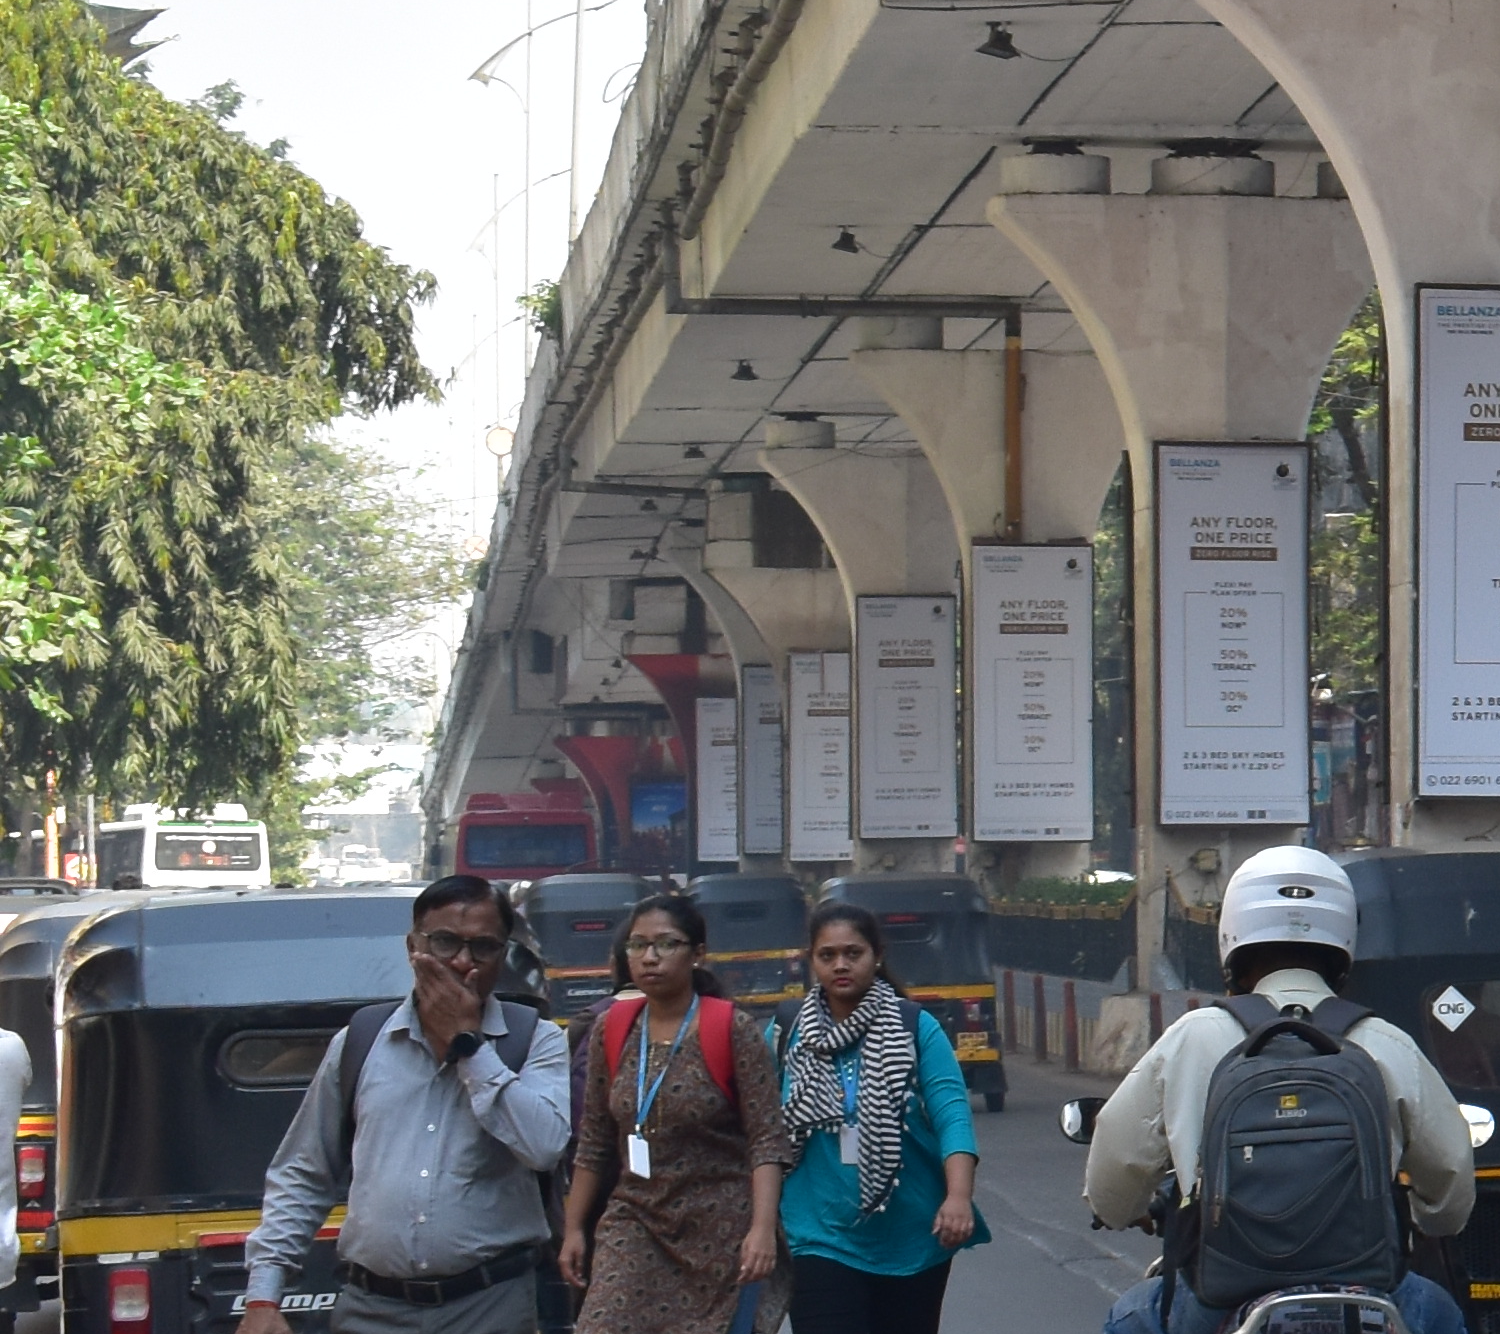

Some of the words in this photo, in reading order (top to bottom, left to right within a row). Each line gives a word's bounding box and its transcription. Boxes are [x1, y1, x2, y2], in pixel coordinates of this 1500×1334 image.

[1471, 427, 1500, 436] ZERO
[1440, 776, 1460, 785] 022
[1465, 776, 1490, 785] 6901
[1438, 1003, 1465, 1015] CNG
